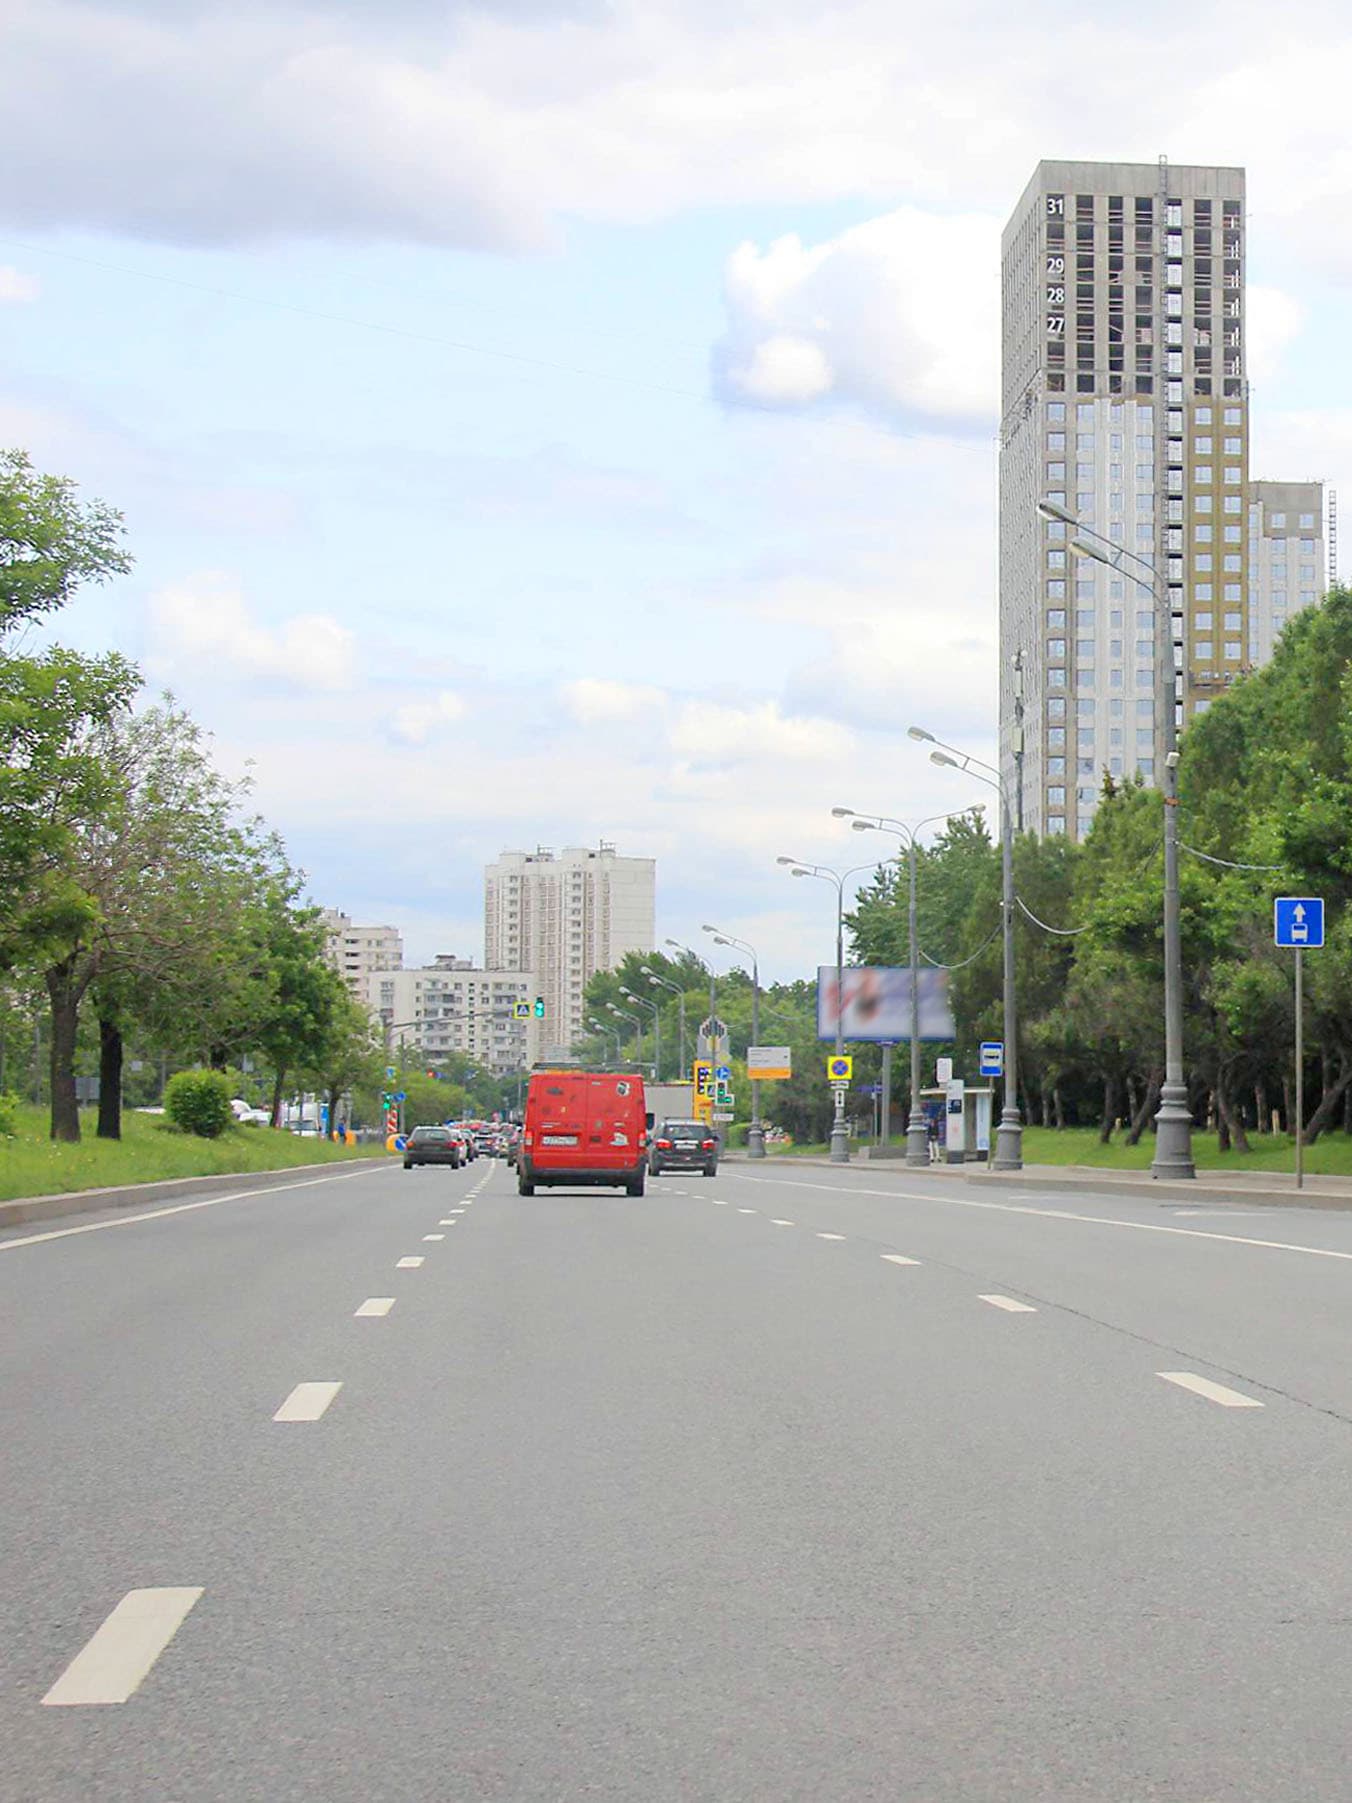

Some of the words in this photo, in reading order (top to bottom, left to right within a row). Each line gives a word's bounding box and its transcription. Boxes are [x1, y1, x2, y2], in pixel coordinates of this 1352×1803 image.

[1047, 198, 1063, 215] 31
[1047, 258, 1064, 274] 29
[1047, 288, 1064, 303] 28
[1047, 317, 1065, 333] 27
